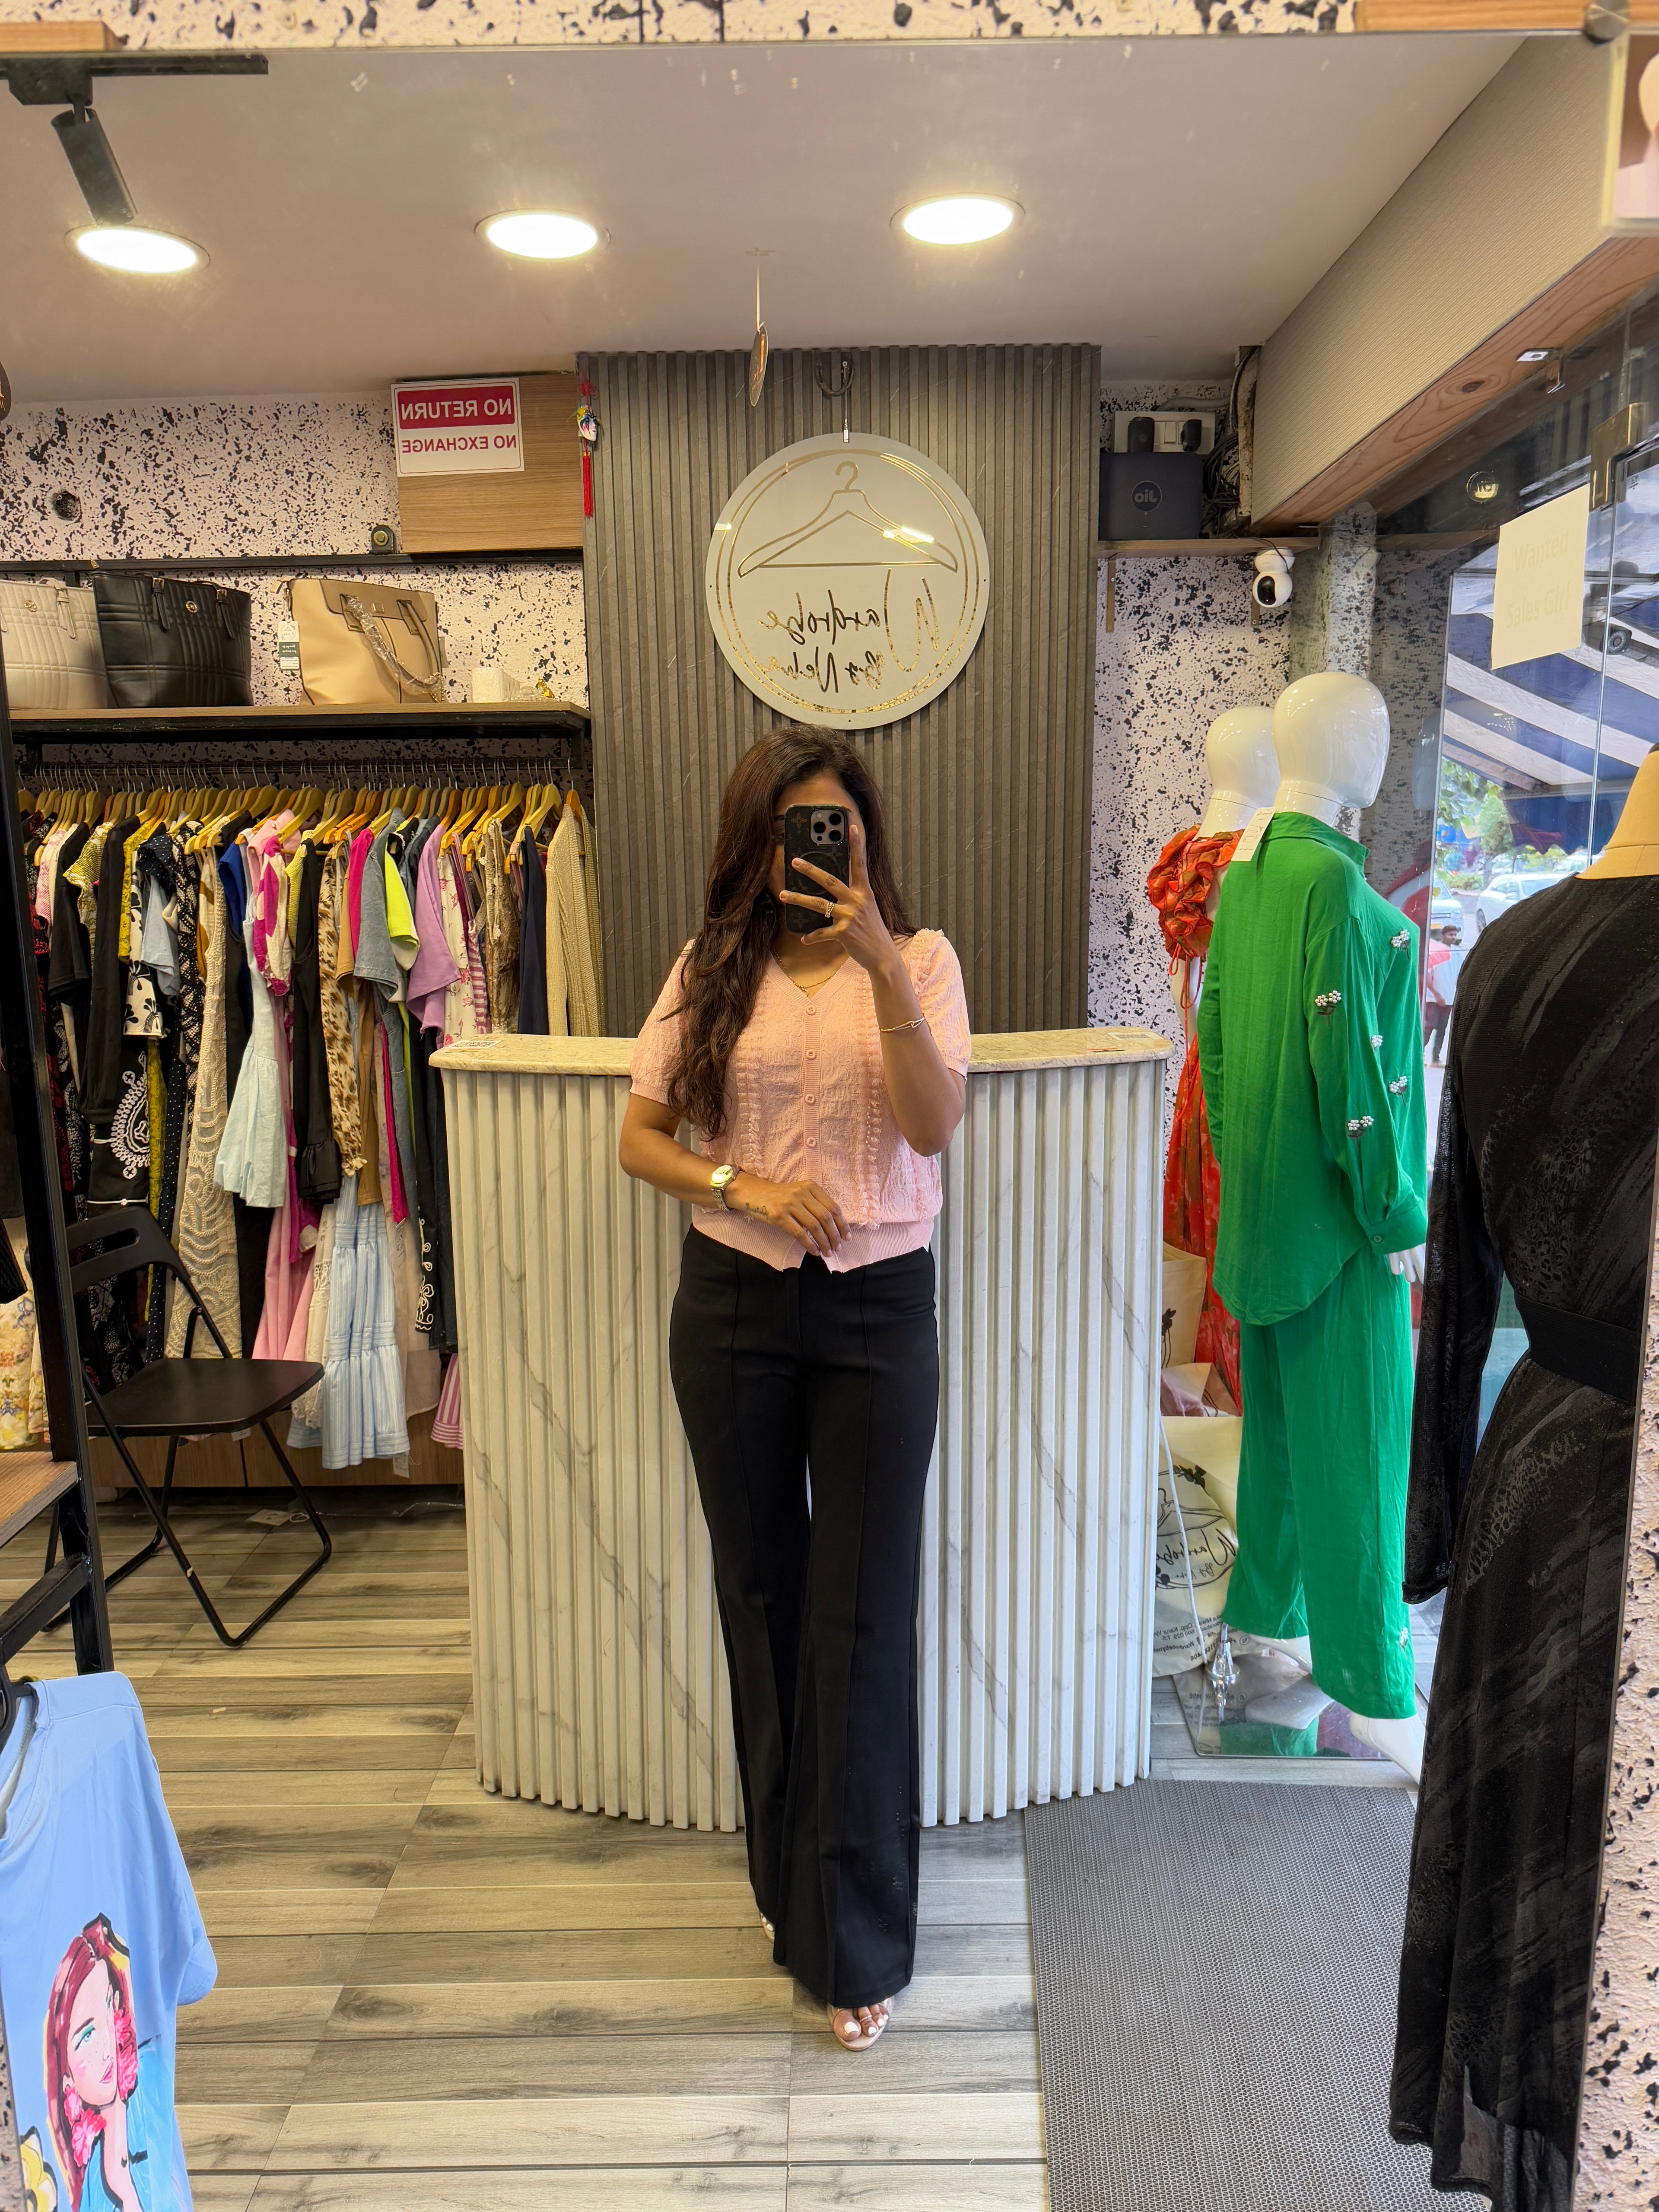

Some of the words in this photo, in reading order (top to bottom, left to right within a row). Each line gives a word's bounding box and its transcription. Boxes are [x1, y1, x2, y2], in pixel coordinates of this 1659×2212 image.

[1514, 525, 1569, 572] Wanted
[1506, 596, 1539, 628] Sales
[1544, 581, 1570, 616] Girl
